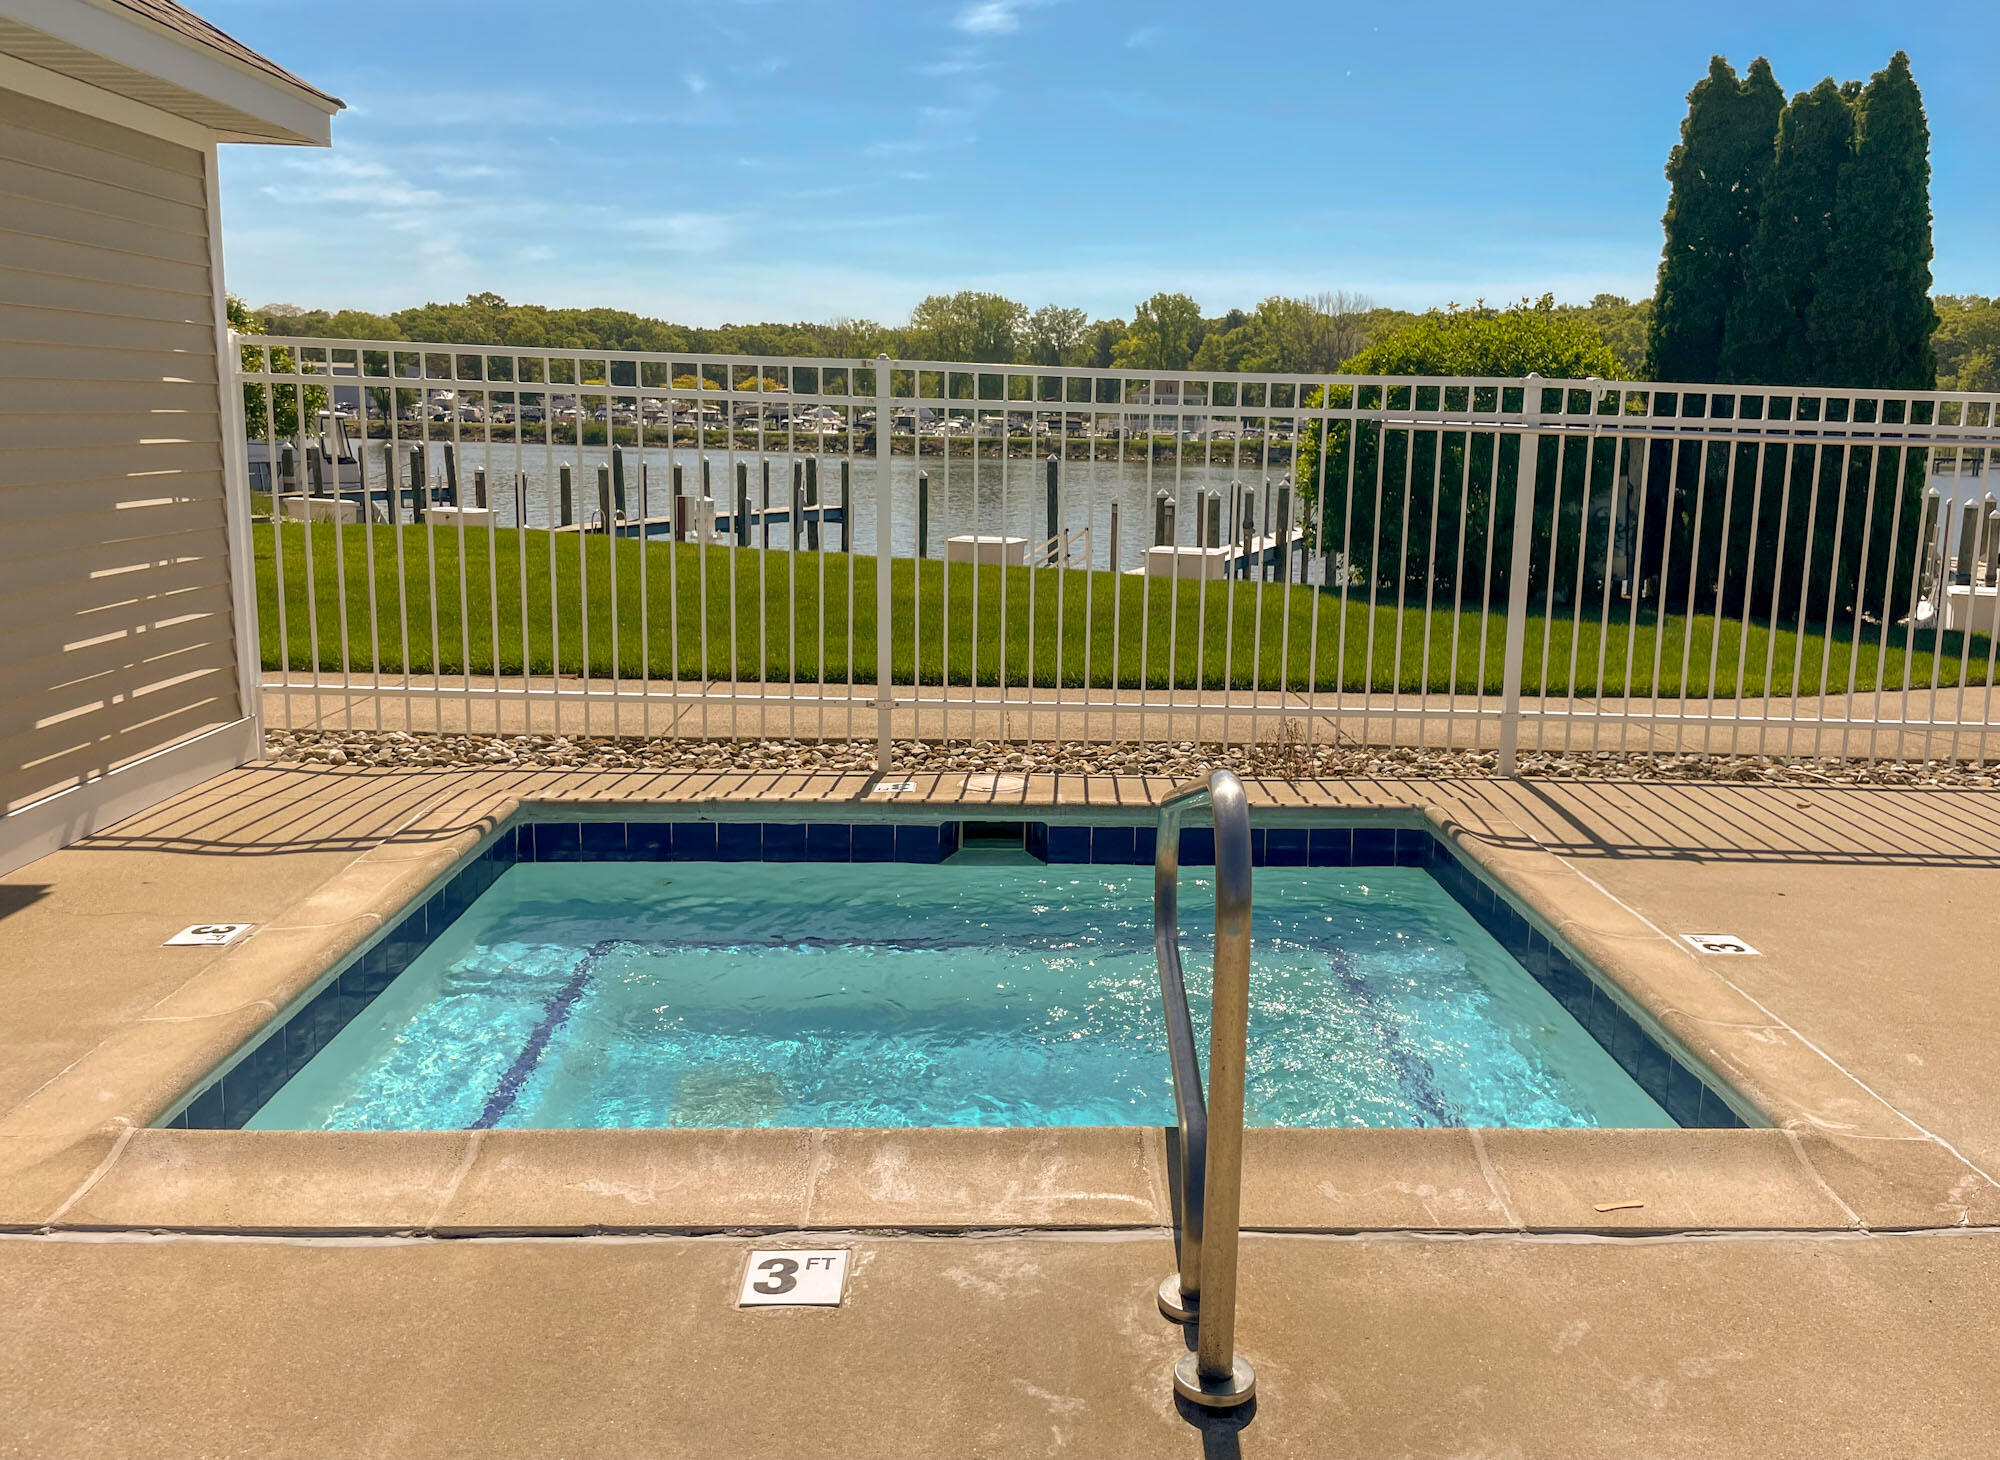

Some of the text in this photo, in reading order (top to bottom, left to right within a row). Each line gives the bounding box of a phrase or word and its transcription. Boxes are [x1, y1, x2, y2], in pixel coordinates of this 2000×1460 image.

[191, 926, 236, 934] 3
[1702, 943, 1745, 952] 3
[753, 1257, 837, 1294] 3 FT
